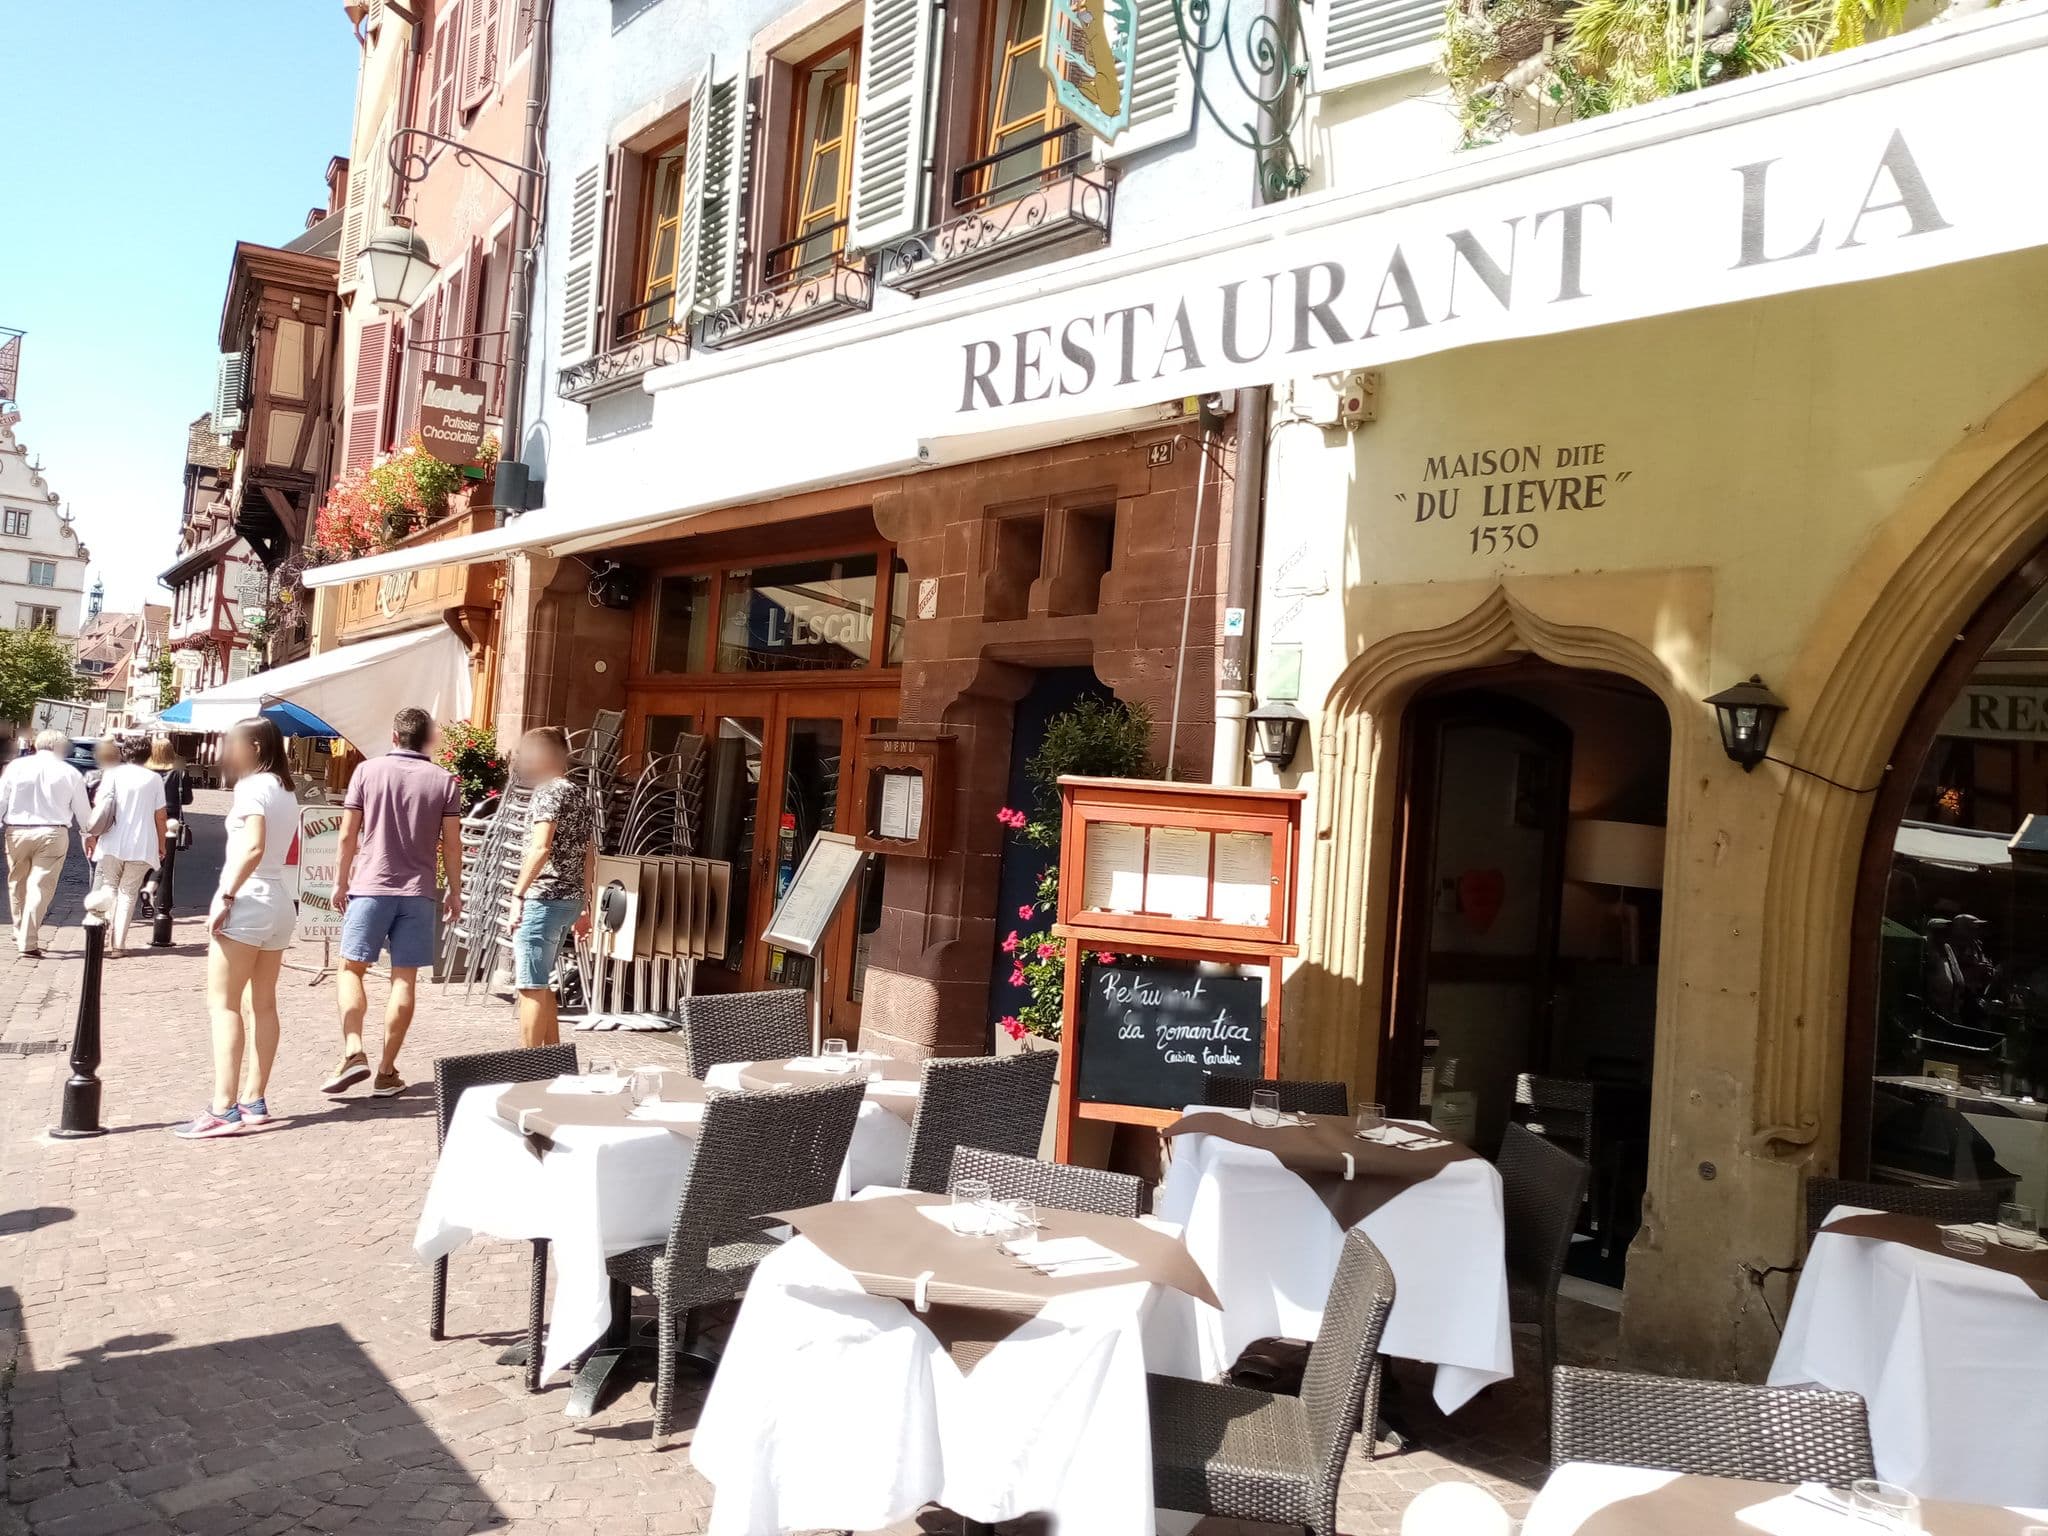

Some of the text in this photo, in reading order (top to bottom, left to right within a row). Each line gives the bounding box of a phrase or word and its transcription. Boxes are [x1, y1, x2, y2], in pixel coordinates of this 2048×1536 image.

[956, 127, 1954, 413] RESTAURANT LA
[422, 425, 480, 444] Chocolatier
[1151, 444, 1168, 463] 42
[1423, 443, 1606, 482] MAISON DITE
[1469, 523, 1539, 555] 1530
[1967, 694, 2048, 732] RE
[883, 741, 915, 753] MENU
[304, 815, 344, 840] NOS SP
[304, 865, 335, 881] SAN
[301, 891, 331, 911] QUICH
[1202, 1045, 1242, 1066] tardive
